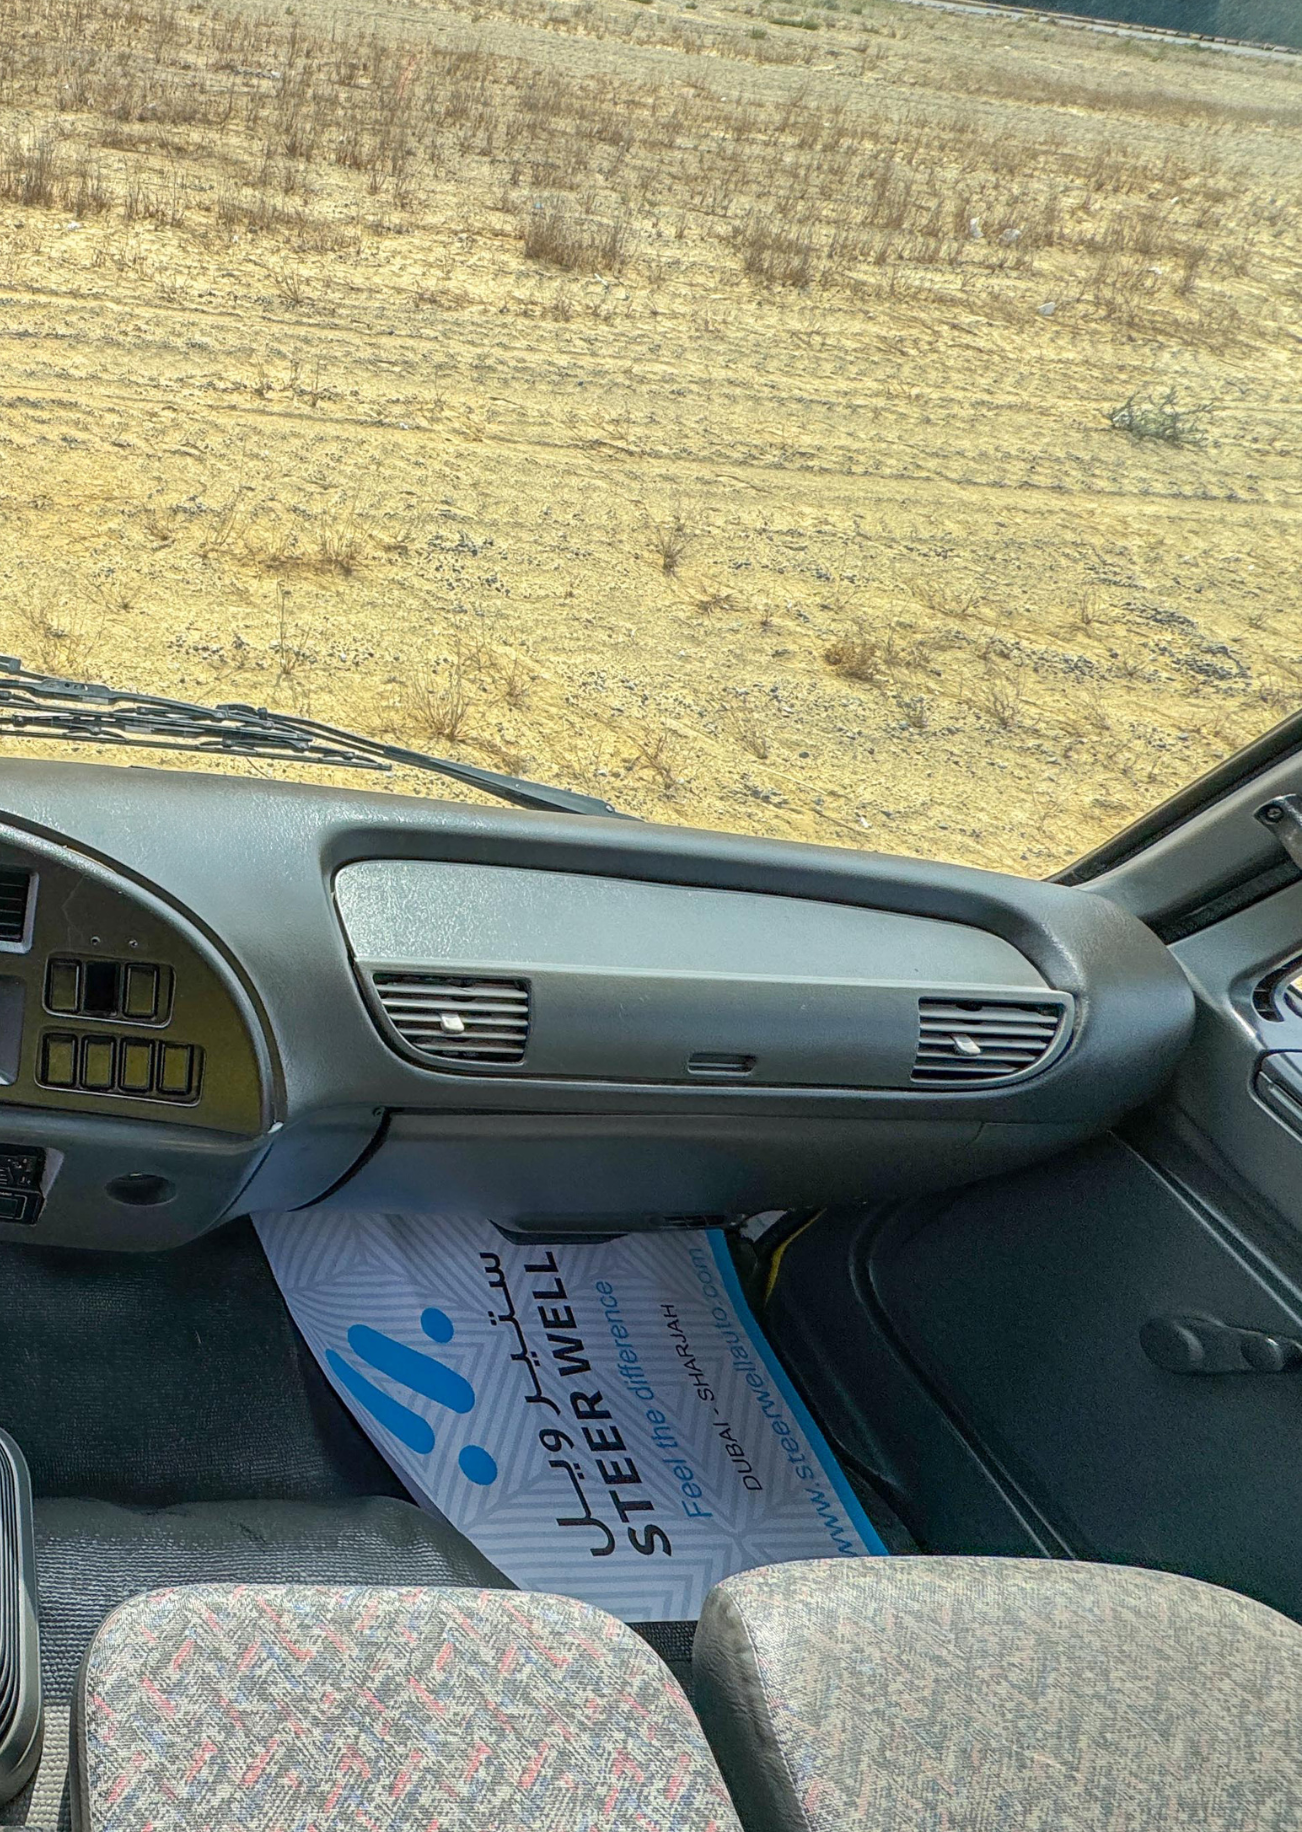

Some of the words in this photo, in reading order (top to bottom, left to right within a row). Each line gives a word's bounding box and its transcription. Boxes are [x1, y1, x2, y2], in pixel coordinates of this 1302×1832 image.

[524, 1251, 591, 1377] WELL
[595, 1280, 654, 1400] difference
[660, 1303, 715, 1402] SHARJAH
[569, 1390, 672, 1556] STEER
[645, 1409, 678, 1449] the
[712, 1421, 763, 1491] DUBAI
[538, 1428, 615, 1556] ويل
[662, 1458, 714, 1518] Feel
